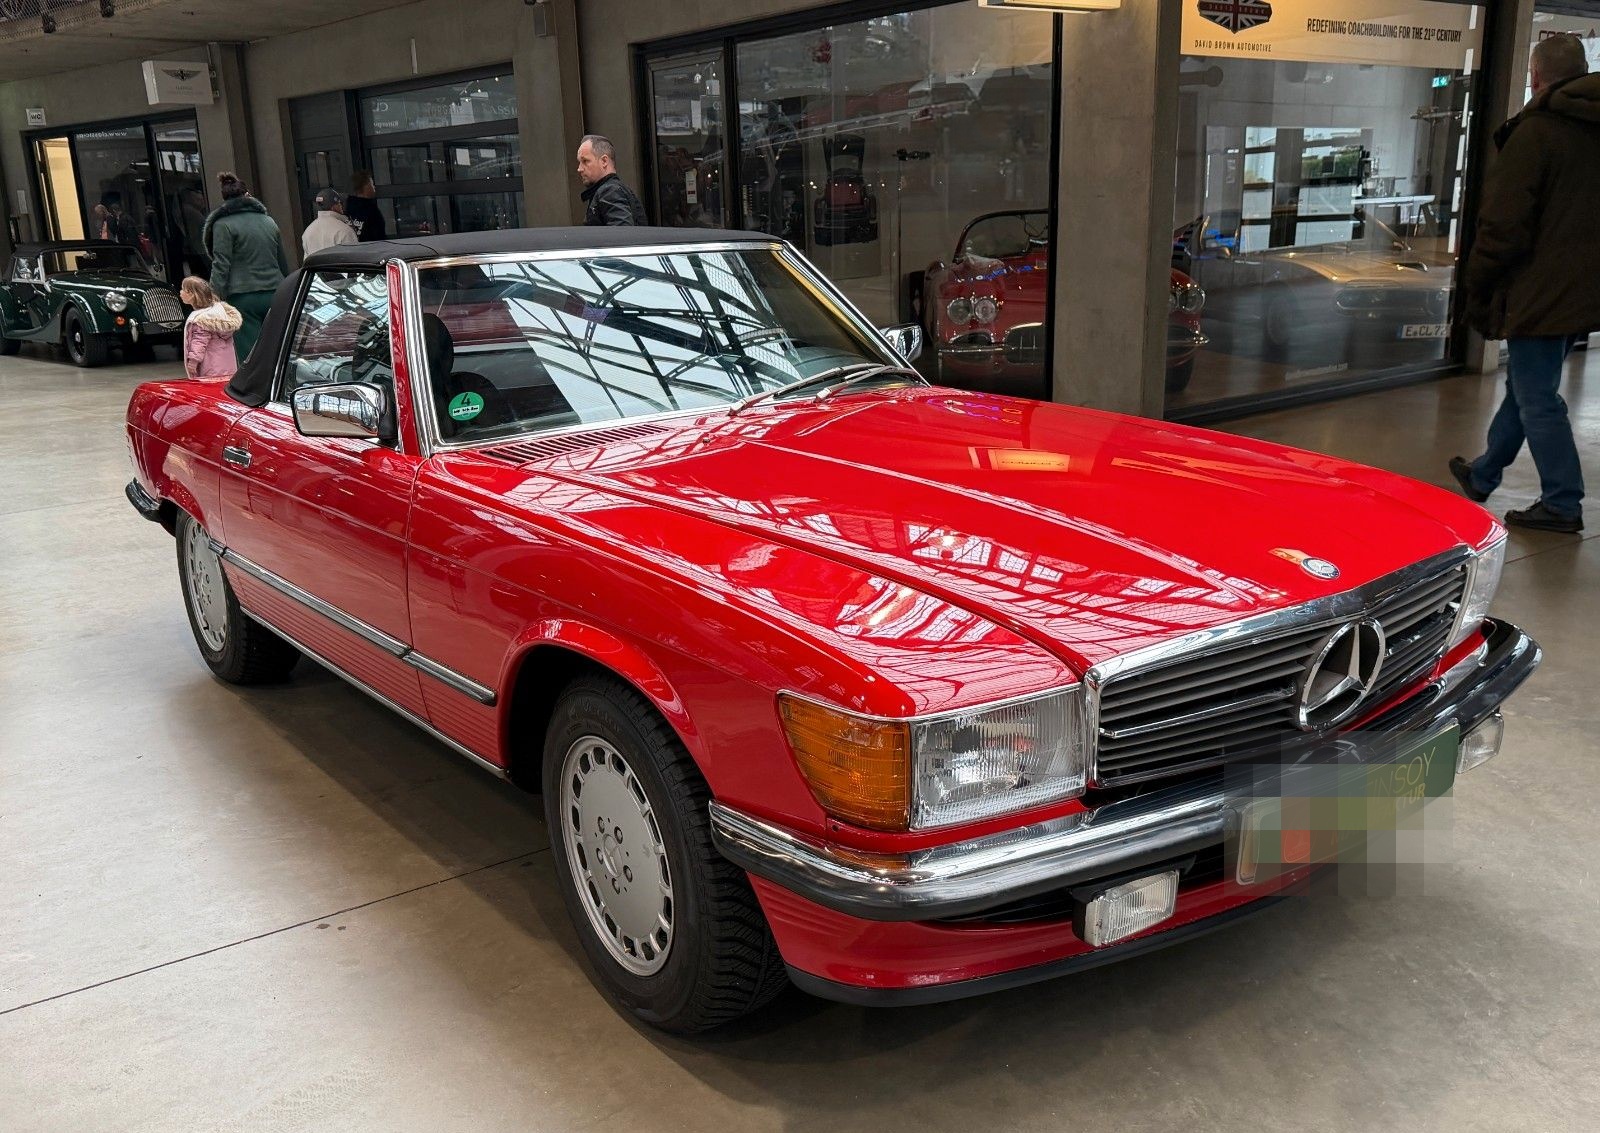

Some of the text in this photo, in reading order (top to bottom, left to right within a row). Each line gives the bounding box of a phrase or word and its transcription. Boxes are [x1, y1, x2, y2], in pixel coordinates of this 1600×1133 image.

[1306, 18, 1347, 35] REDEFINING
[1348, 21, 1398, 39] COACHBUILDING
[1399, 25, 1411, 40] FOR
[1412, 26, 1423, 40] THE
[1437, 28, 1462, 43] CENTURY
[1195, 40, 1272, 53] DAVID BROWN AUTOMOTIVE
[30, 113, 41, 121] WC
[461, 391, 472, 406] 4
